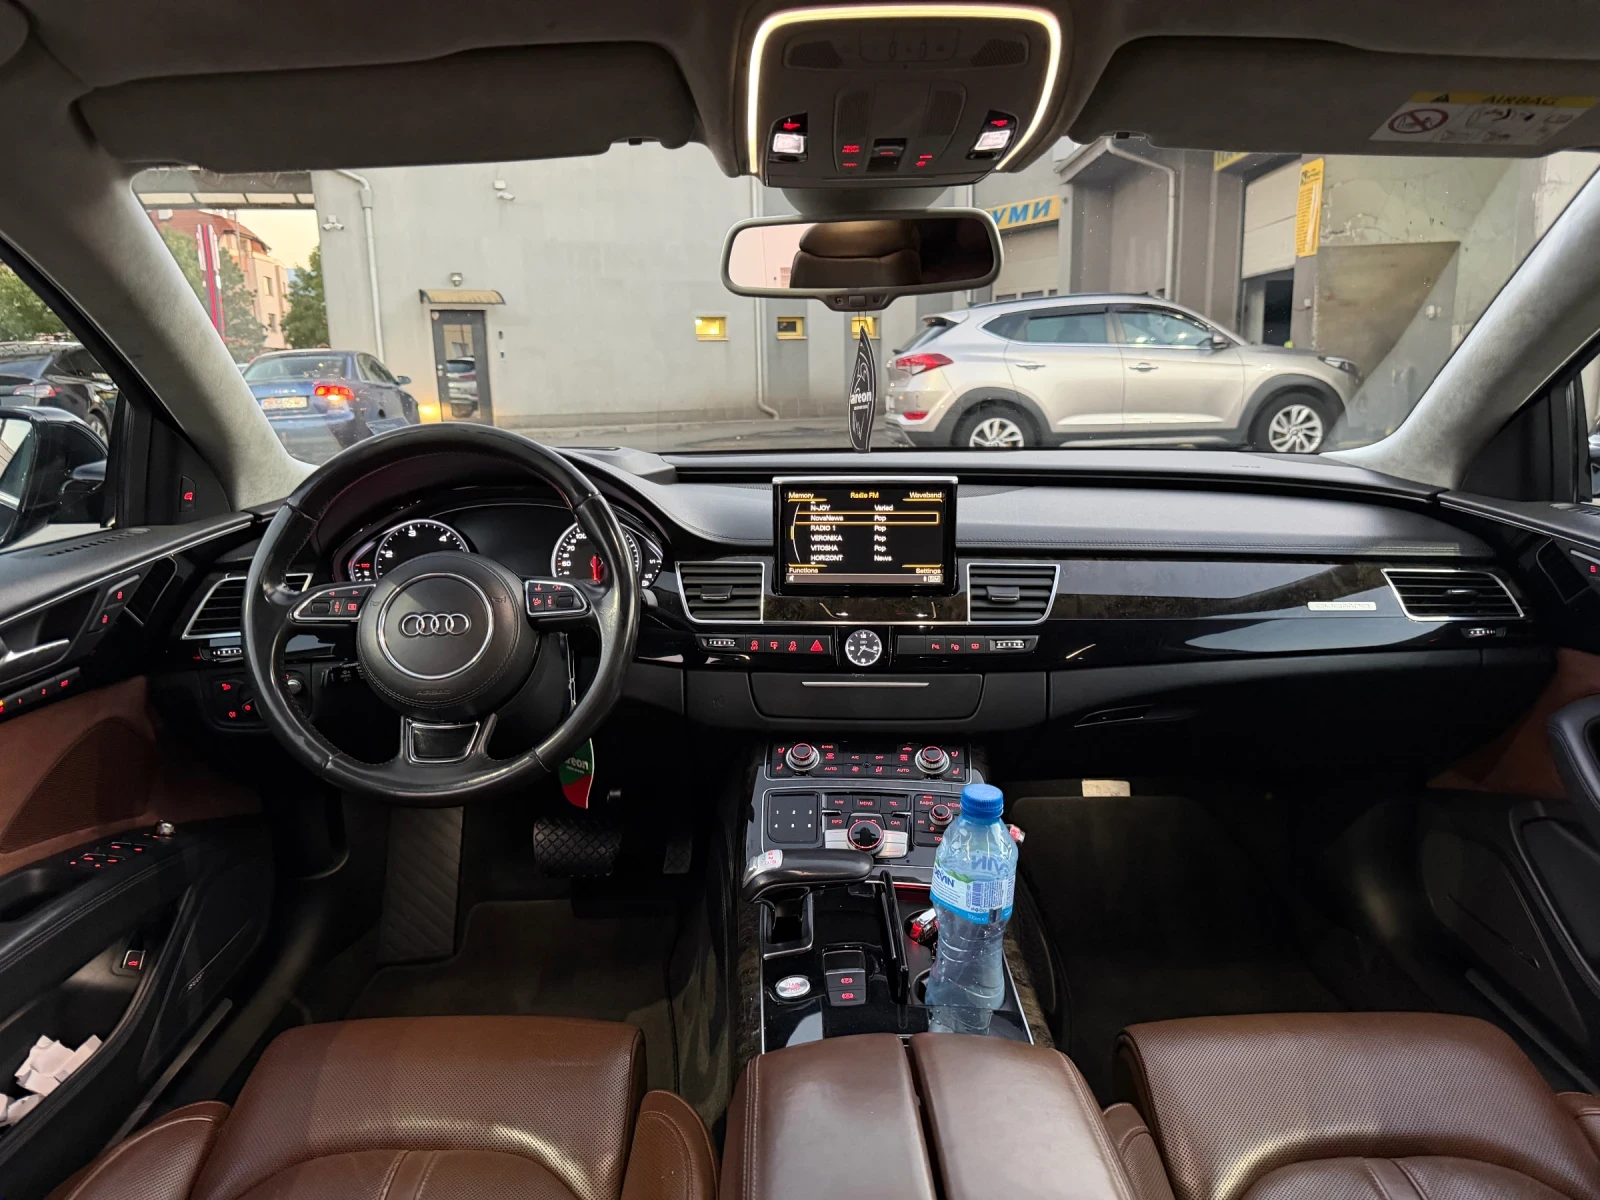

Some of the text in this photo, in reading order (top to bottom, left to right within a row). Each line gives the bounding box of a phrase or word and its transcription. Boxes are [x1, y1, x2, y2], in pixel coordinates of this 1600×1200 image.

[992, 199, 1052, 226] УМИ
[850, 391, 872, 405] areon
[788, 491, 814, 499] Memory
[850, 491, 879, 499] Radio FM
[909, 491, 942, 499] Waveband
[874, 515, 887, 523] Pop
[874, 525, 887, 533] Pop
[874, 535, 887, 543] Pop
[810, 544, 838, 552] VITOSHA
[874, 545, 887, 553] Pop
[874, 554, 892, 562] News
